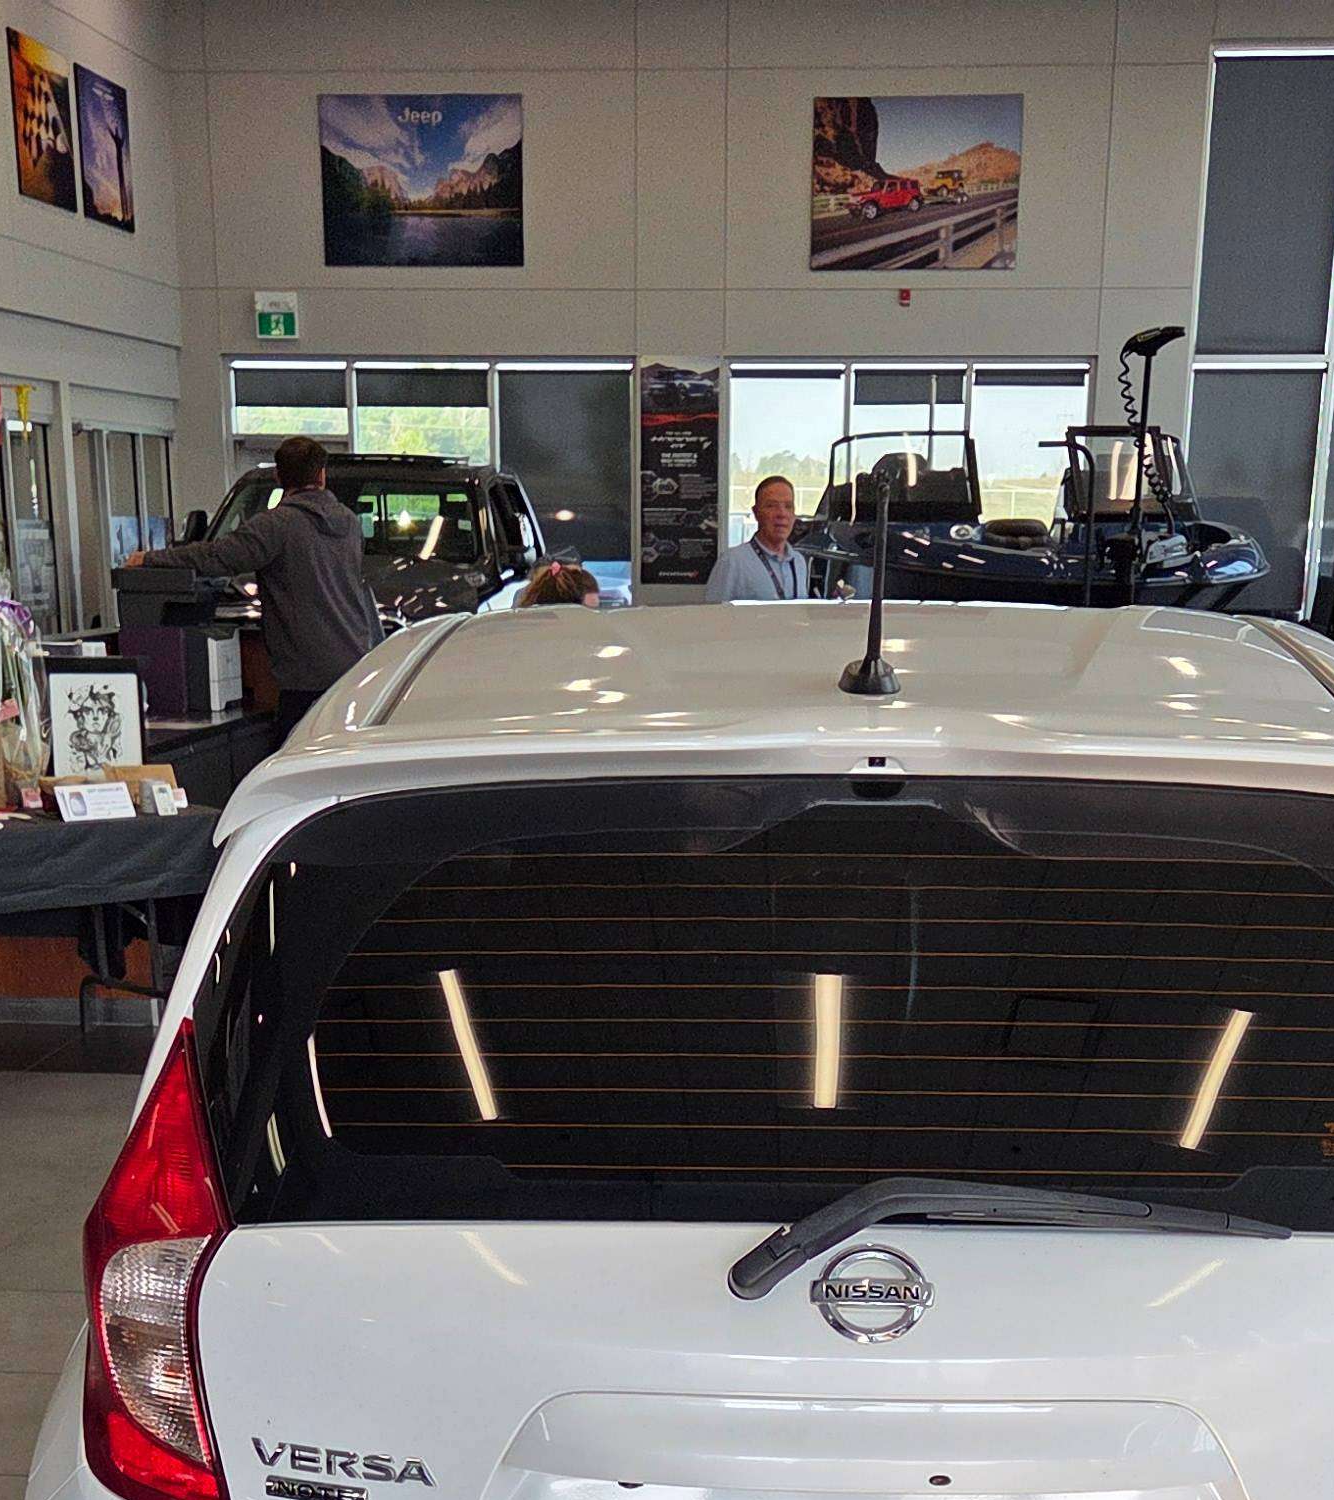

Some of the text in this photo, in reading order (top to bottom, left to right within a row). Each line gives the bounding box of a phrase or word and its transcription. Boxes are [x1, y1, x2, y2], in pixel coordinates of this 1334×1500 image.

[397, 107, 443, 126] Jeep
[824, 1284, 920, 1300] NISSAN
[251, 1436, 437, 1488] VERSA
